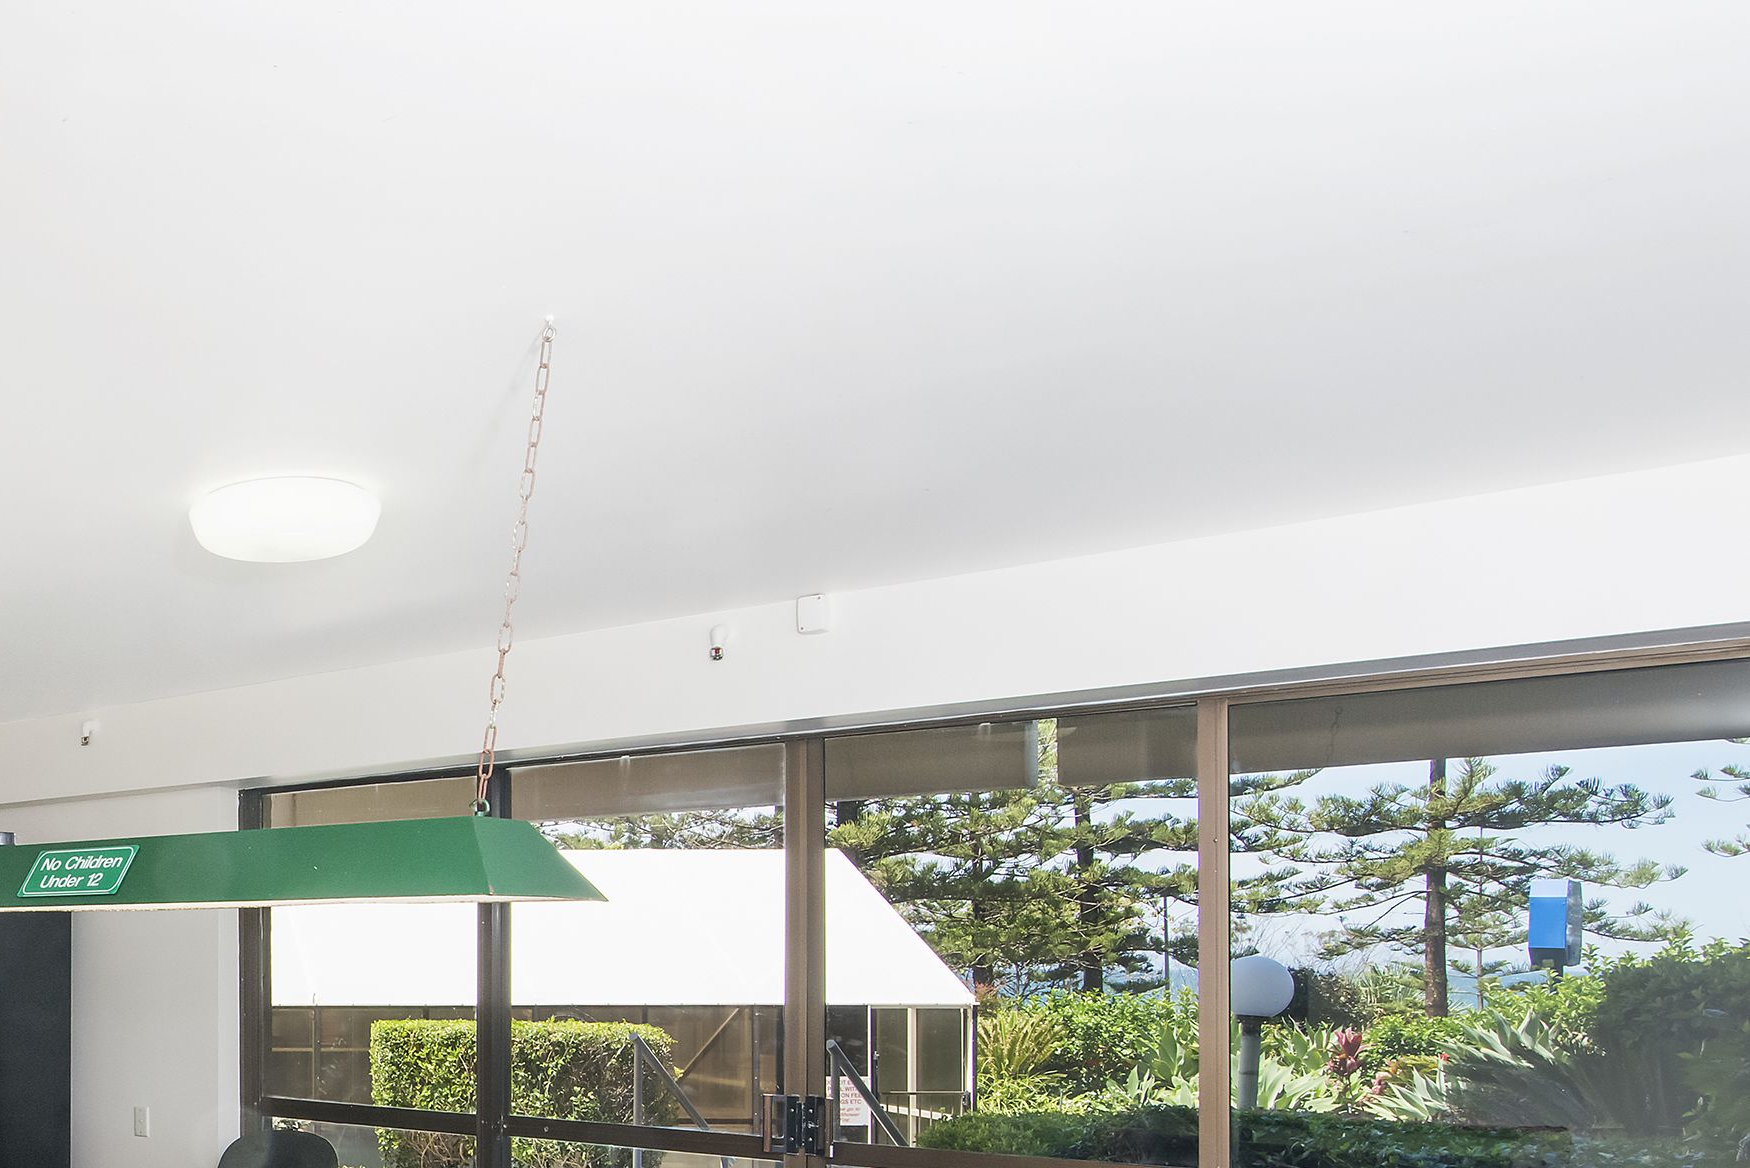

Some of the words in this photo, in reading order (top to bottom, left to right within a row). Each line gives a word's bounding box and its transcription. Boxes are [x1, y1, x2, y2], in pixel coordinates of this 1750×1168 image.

[40, 858, 61, 871] No
[65, 855, 123, 870] Children
[40, 874, 84, 888] Under
[87, 873, 103, 887] 12
